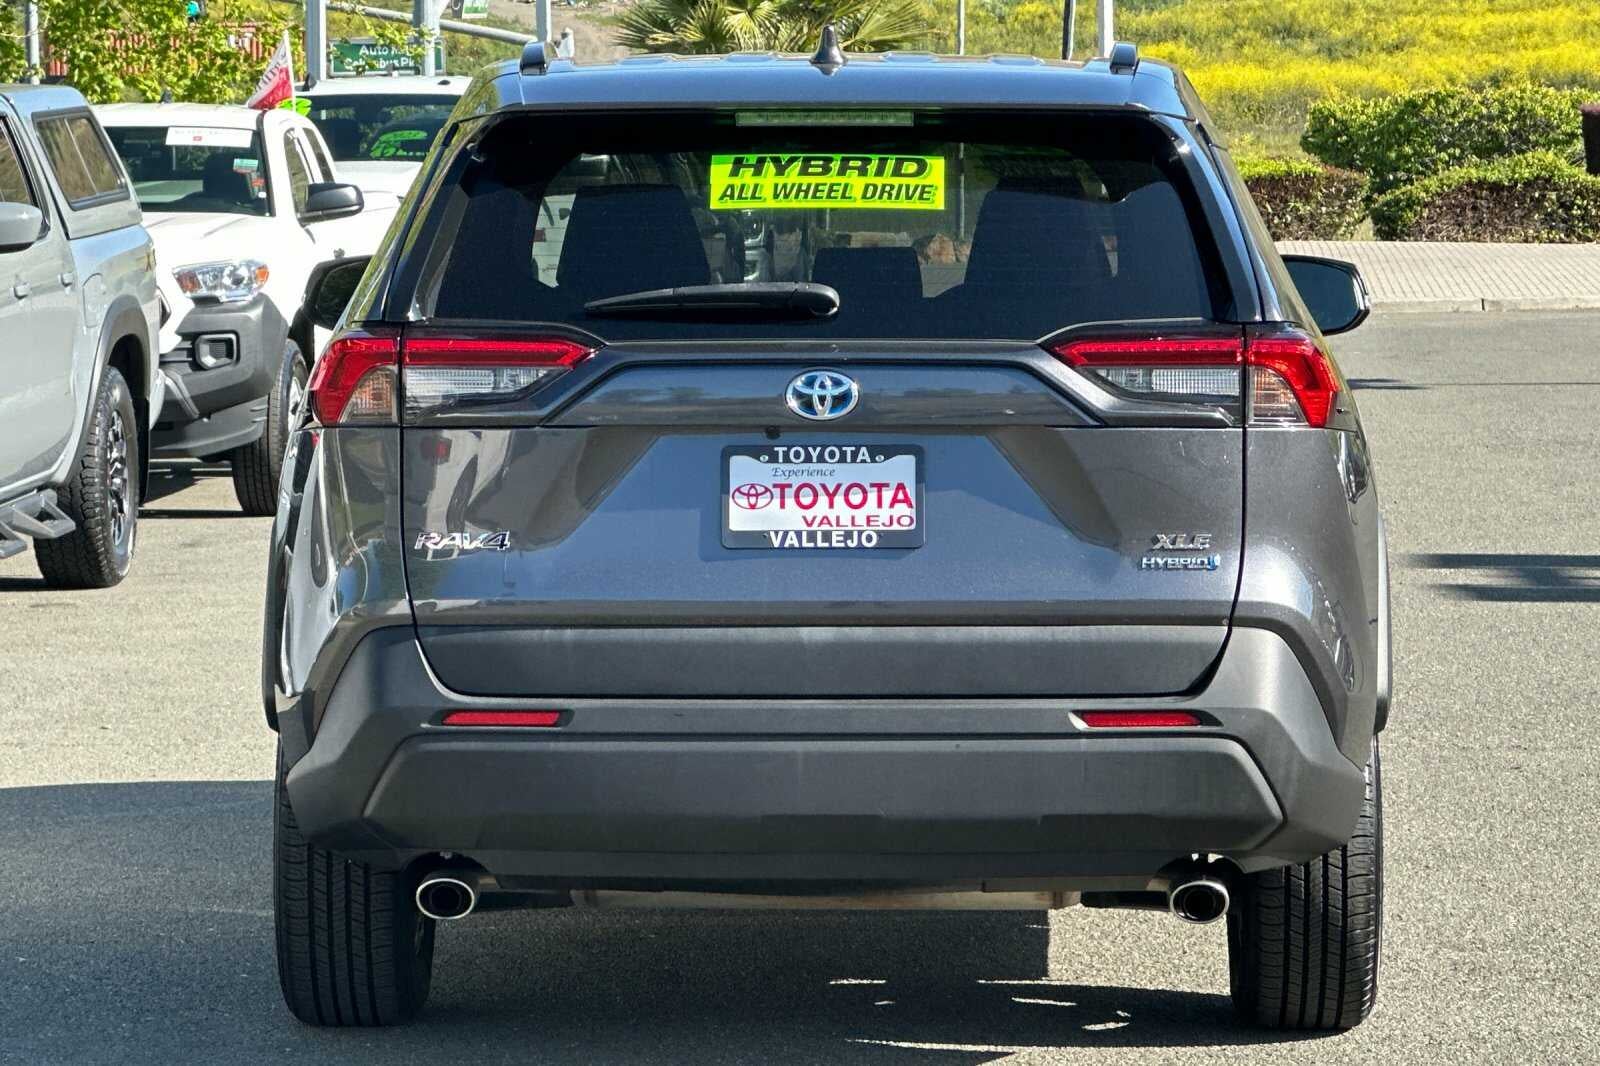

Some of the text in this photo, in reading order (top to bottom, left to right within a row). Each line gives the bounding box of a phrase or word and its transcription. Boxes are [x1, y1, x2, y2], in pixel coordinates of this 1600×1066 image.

[359, 45, 388, 55] Auto
[728, 155, 931, 178] HYBRID
[719, 183, 936, 202] ALL WHEEL DRIVE
[774, 446, 871, 463] TOYOTA
[771, 466, 836, 480] Experience
[773, 482, 914, 510] TOYOTA
[802, 514, 915, 528] VALLEJO
[414, 531, 511, 551] RAV4
[769, 530, 878, 548] VALLEJO
[1152, 533, 1212, 549] XLE
[1141, 556, 1209, 569] HYBRID
